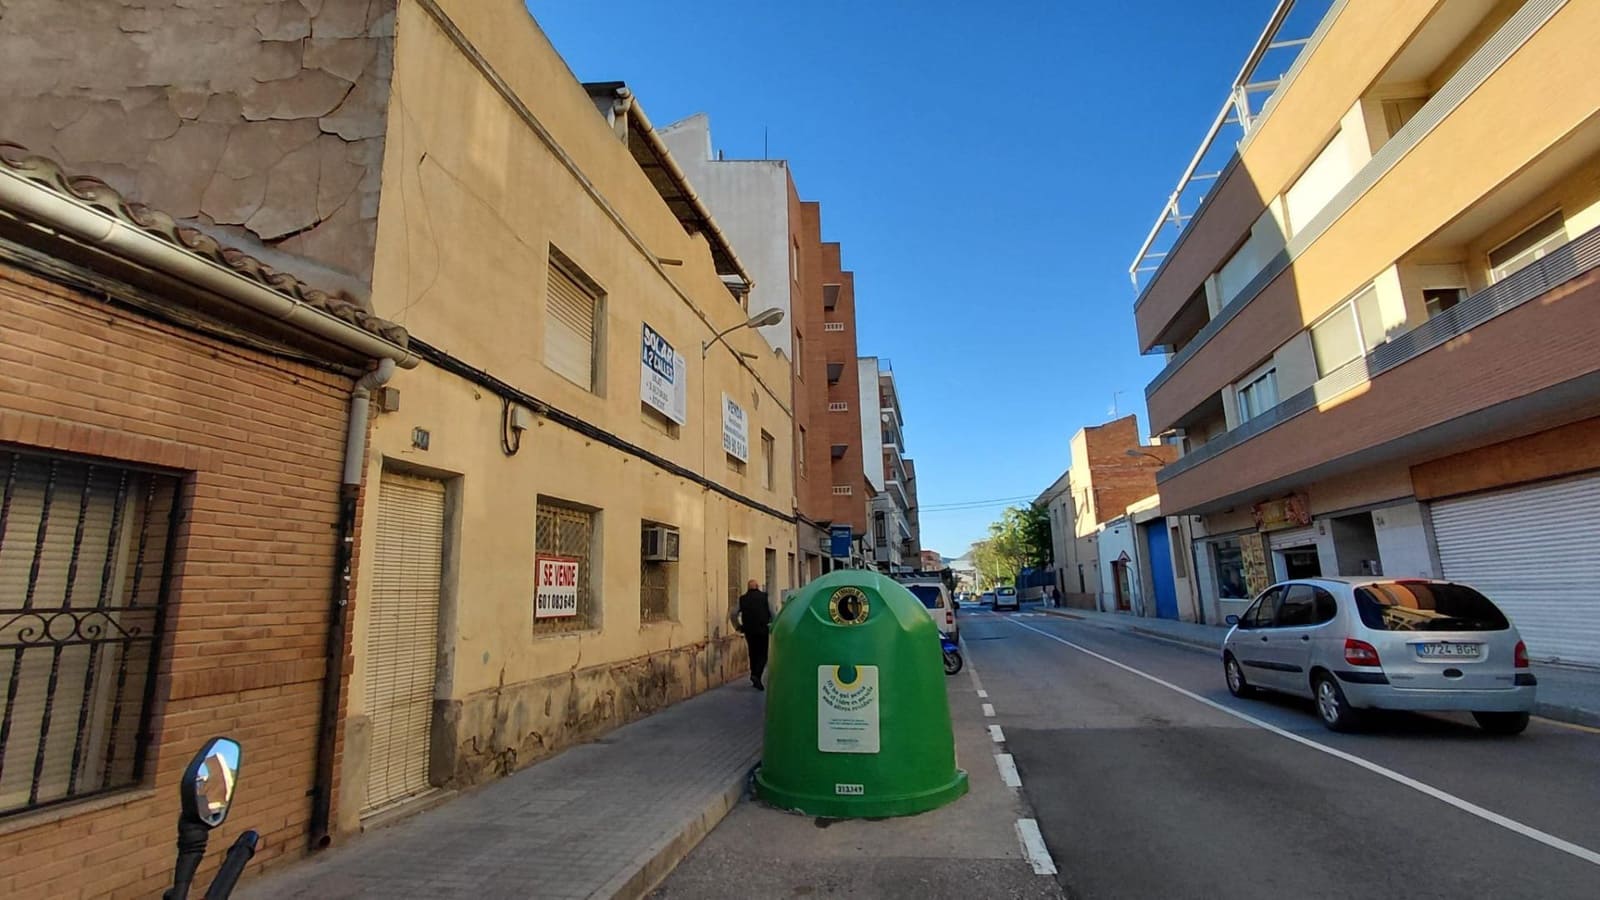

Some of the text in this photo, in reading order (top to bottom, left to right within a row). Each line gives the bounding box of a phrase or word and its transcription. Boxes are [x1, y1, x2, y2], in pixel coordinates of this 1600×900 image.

[644, 327, 673, 366] SOLAR
[649, 351, 654, 367] 2
[544, 563, 575, 587] SE VENDE
[1424, 644, 1478, 655] 0724 BGH
